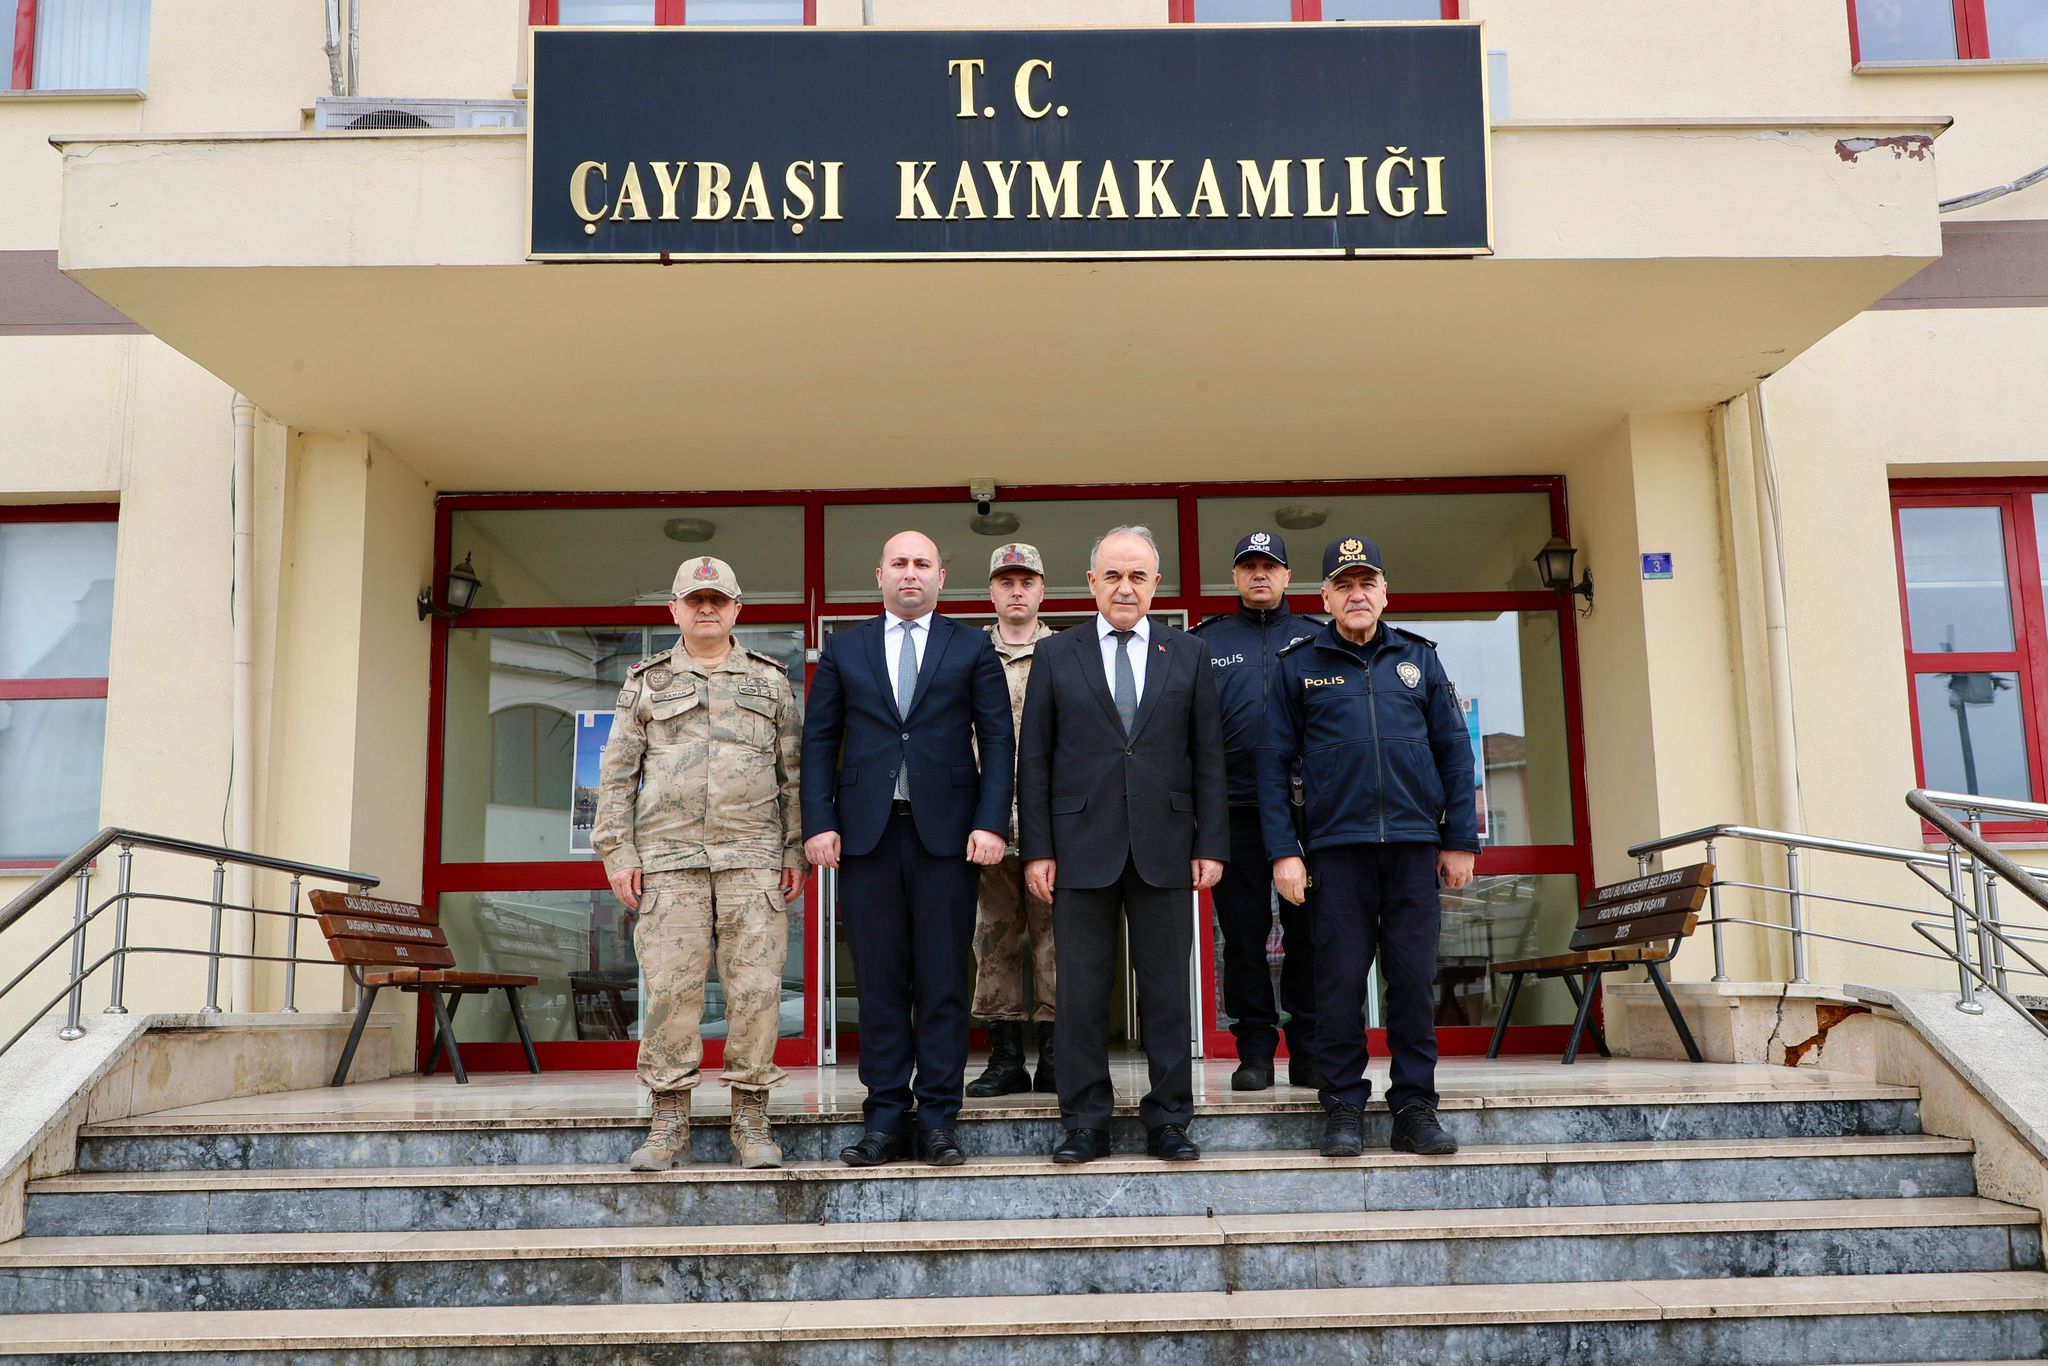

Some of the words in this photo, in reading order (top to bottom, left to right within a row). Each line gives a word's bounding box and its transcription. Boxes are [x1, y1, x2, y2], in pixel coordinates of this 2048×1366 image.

[948, 58, 995, 119] T.
[1014, 58, 1069, 119] C.
[569, 158, 844, 236] ÇAYBAŞI
[895, 144, 1447, 221] KAYMAKAMLIĞI
[1653, 561, 1661, 572] 3
[663, 691, 687, 699] AKMAN
